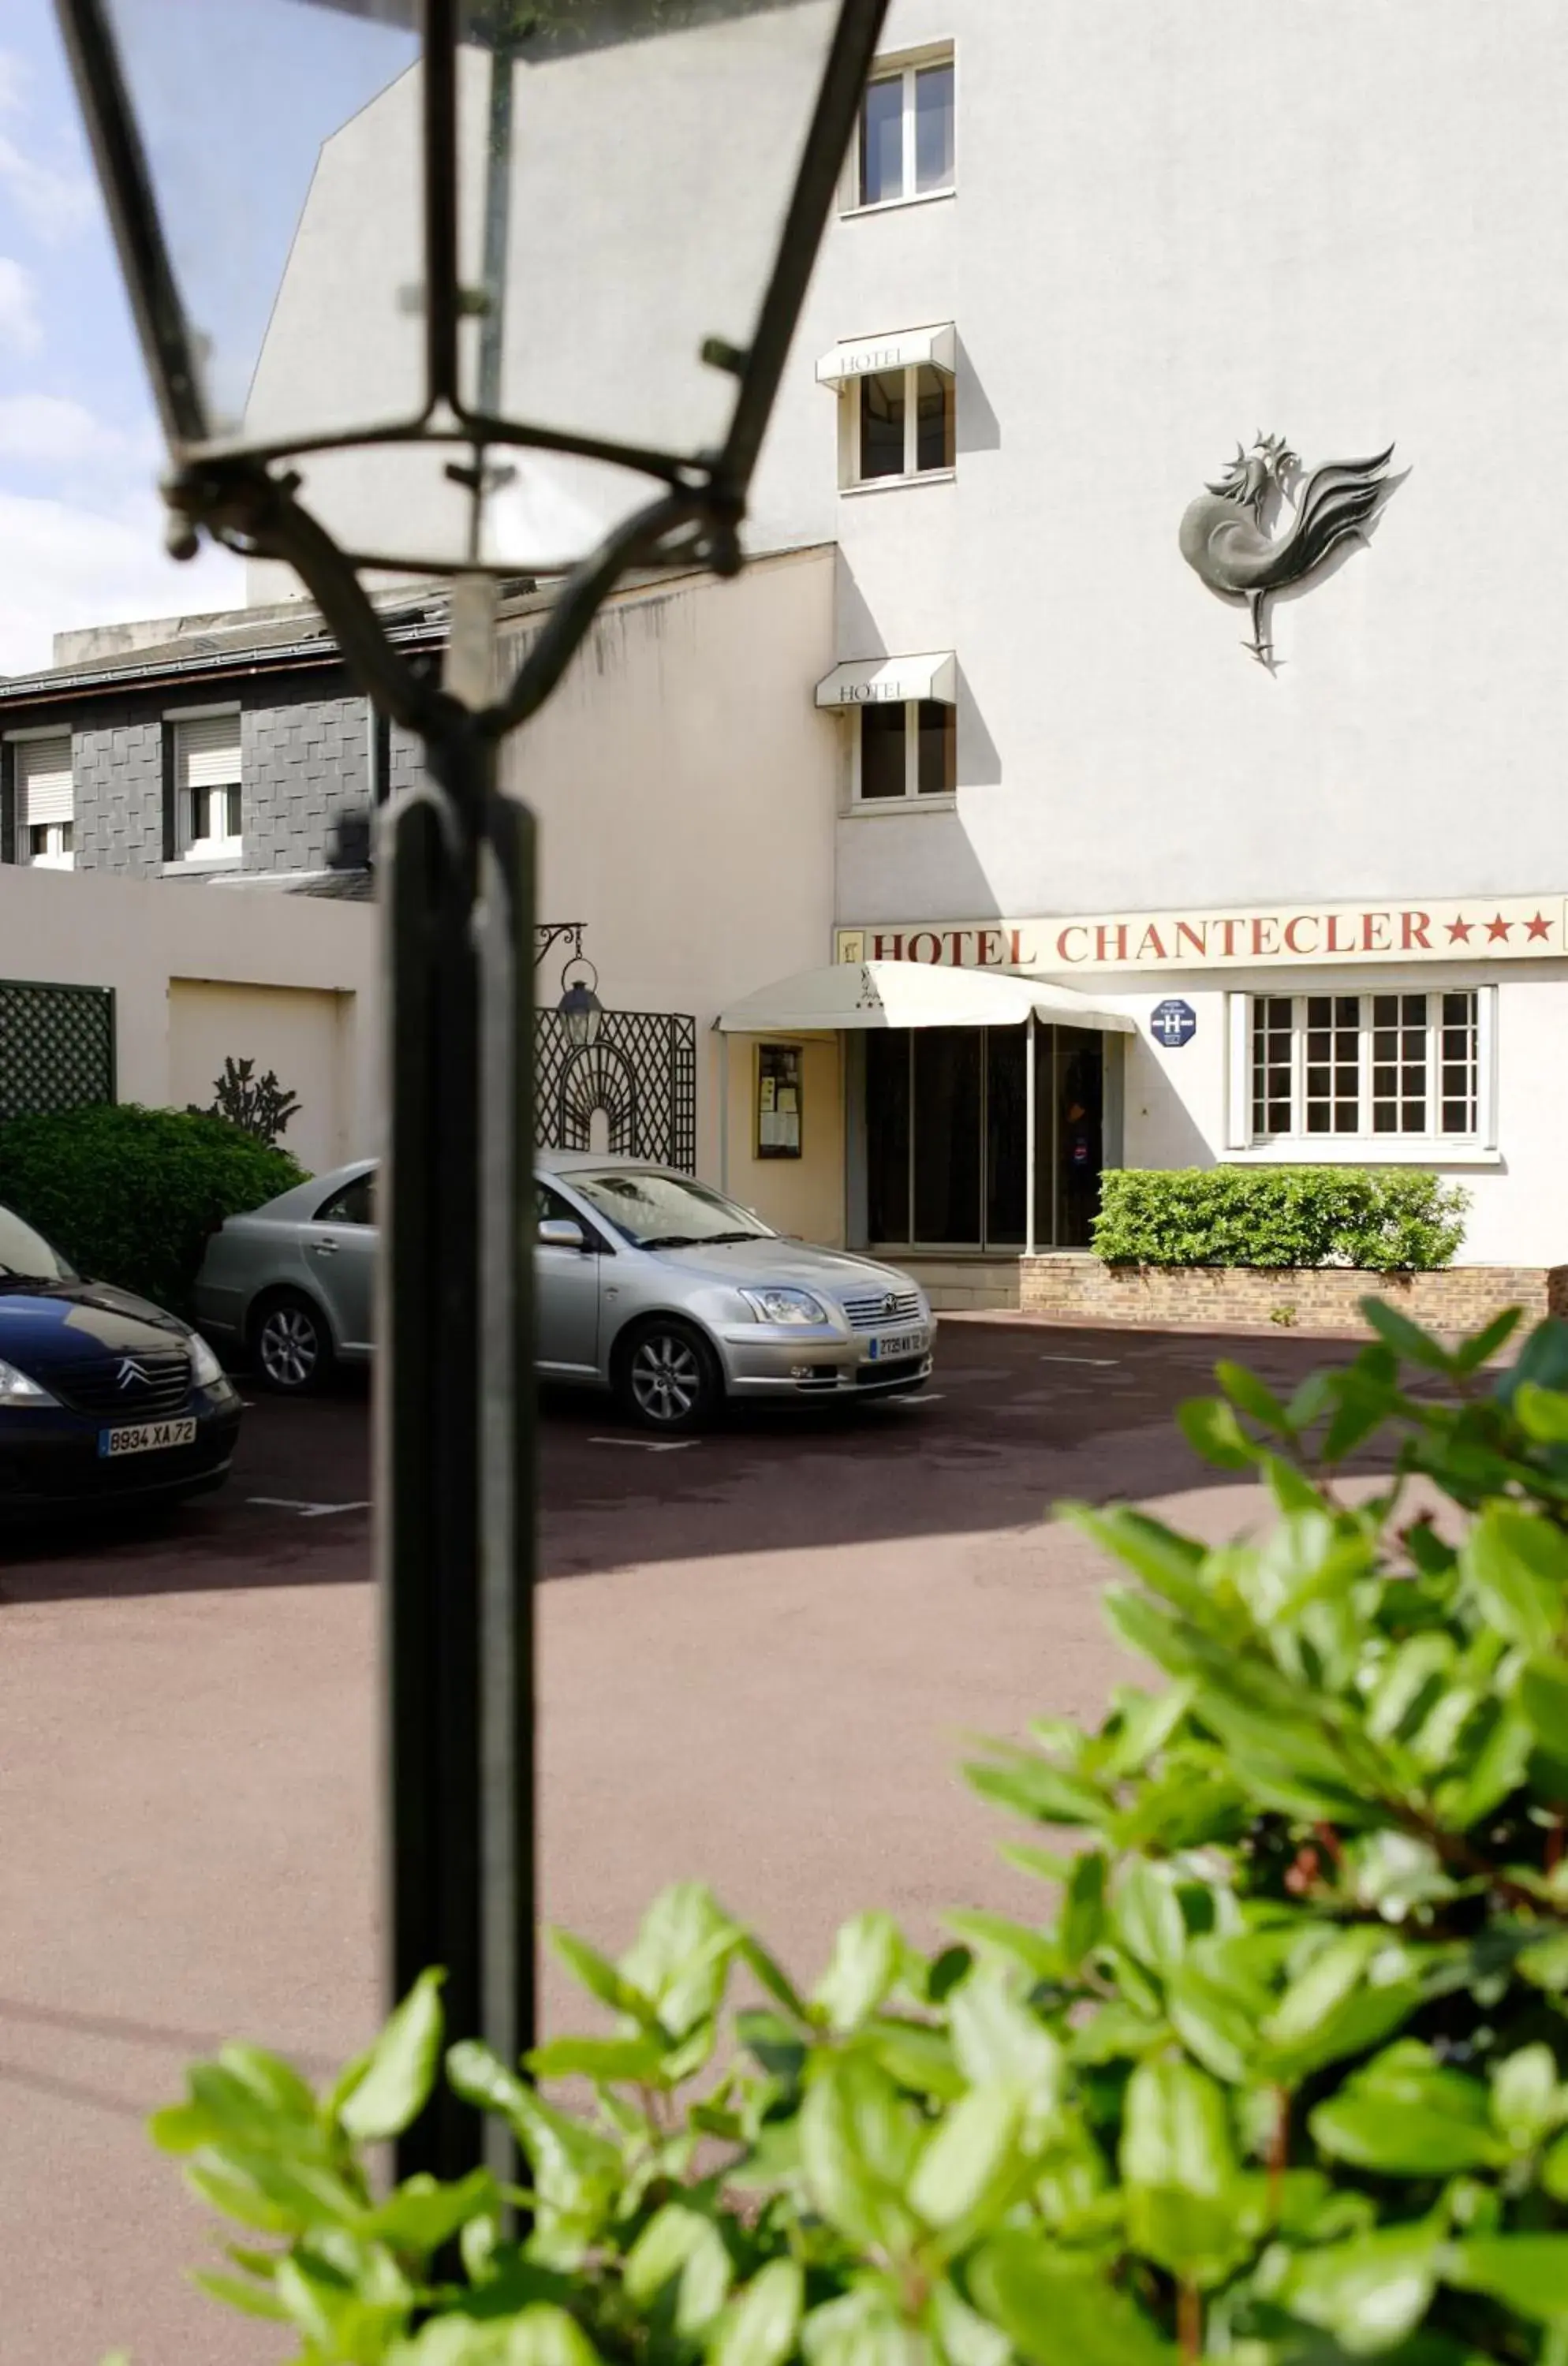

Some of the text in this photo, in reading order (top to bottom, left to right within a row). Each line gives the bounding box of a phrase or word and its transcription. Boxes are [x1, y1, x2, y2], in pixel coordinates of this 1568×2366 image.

[871, 910, 1434, 967] HOTEL CHANTECLER
[1164, 1014, 1181, 1033] H
[110, 1421, 194, 1451] 8934 XA 72
